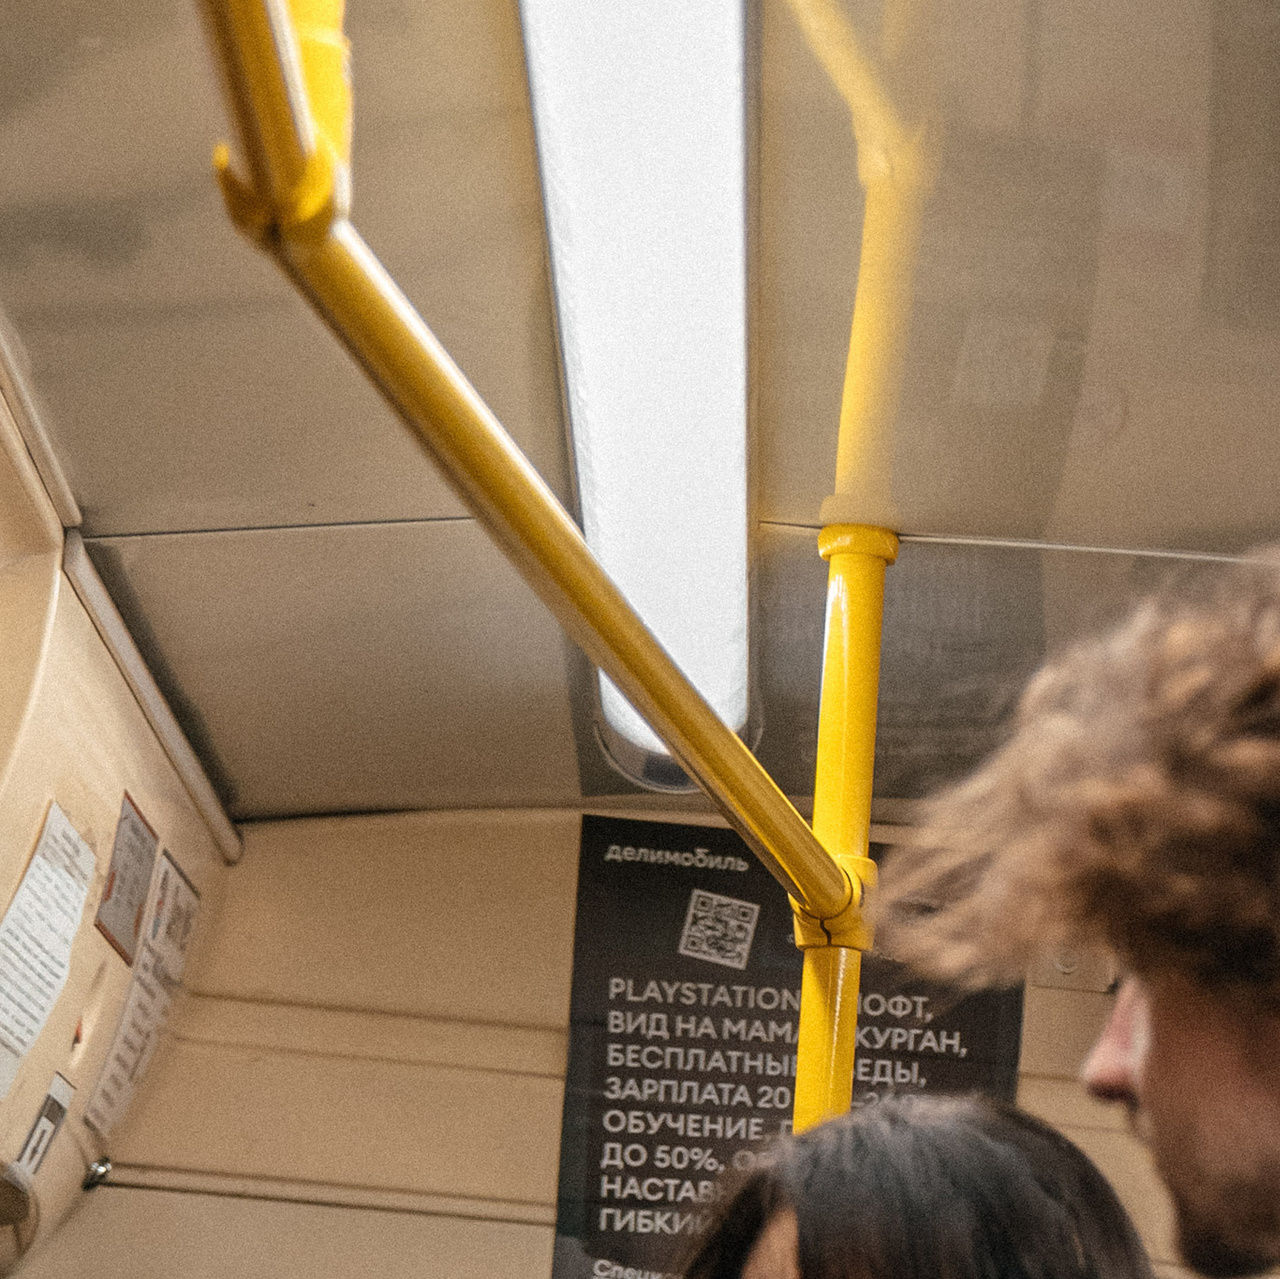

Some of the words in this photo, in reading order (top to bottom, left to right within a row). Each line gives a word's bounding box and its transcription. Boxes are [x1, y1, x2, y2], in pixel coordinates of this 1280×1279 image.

[604, 845, 749, 872] делимобиль
[608, 977, 801, 1012] PLAYSTATION
[856, 993, 934, 1023] ОФТ,
[607, 1009, 671, 1041] ВИД
[675, 1014, 718, 1040] НА
[855, 1026, 968, 1058] КУРГАН,
[606, 1042, 798, 1078] БЕСПЛАТНЫ
[854, 1057, 927, 1088] ЕДЫ,
[602, 1076, 754, 1108] ЗАРПЛАТА
[600, 1142, 649, 1170] ДО
[653, 1145, 727, 1174] 50%,
[600, 1175, 724, 1204] НАСТАВ
